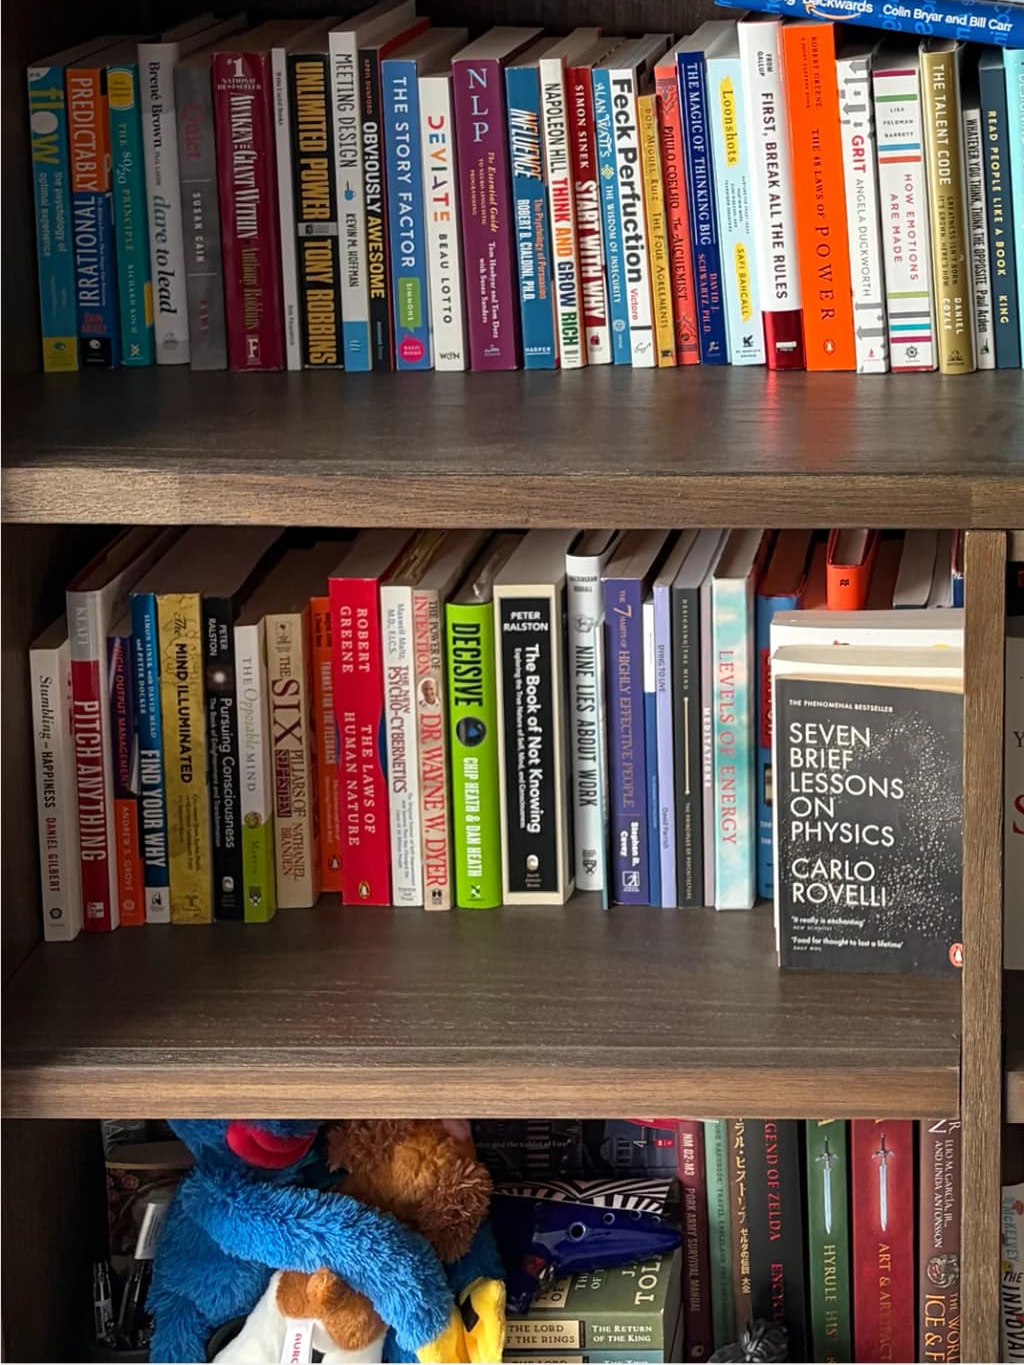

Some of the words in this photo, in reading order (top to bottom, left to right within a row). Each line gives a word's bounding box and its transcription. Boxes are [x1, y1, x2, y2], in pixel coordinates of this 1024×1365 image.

[296, 61, 328, 153] UNLIMITED
[393, 77, 408, 113] THE
[612, 68, 635, 130] Feck
[395, 121, 412, 185] STORY
[300, 158, 330, 220] POWER
[396, 192, 416, 269] FACTOR
[617, 147, 646, 283] Perfuction
[175, 644, 188, 683] MIND
[451, 622, 483, 709] DECISIVE
[804, 700, 852, 711] PHENOMENAL
[855, 704, 893, 713] BESTSELLER
[178, 685, 192, 783] ILLUMINATED
[789, 722, 871, 748] SEVEN
[789, 748, 854, 770] BRIEF
[790, 772, 904, 799] LESSONS
[791, 798, 835, 818] ON
[791, 822, 894, 847] PHYSICS
[791, 859, 875, 880] CARLO
[792, 882, 887, 907] ROVELLI
